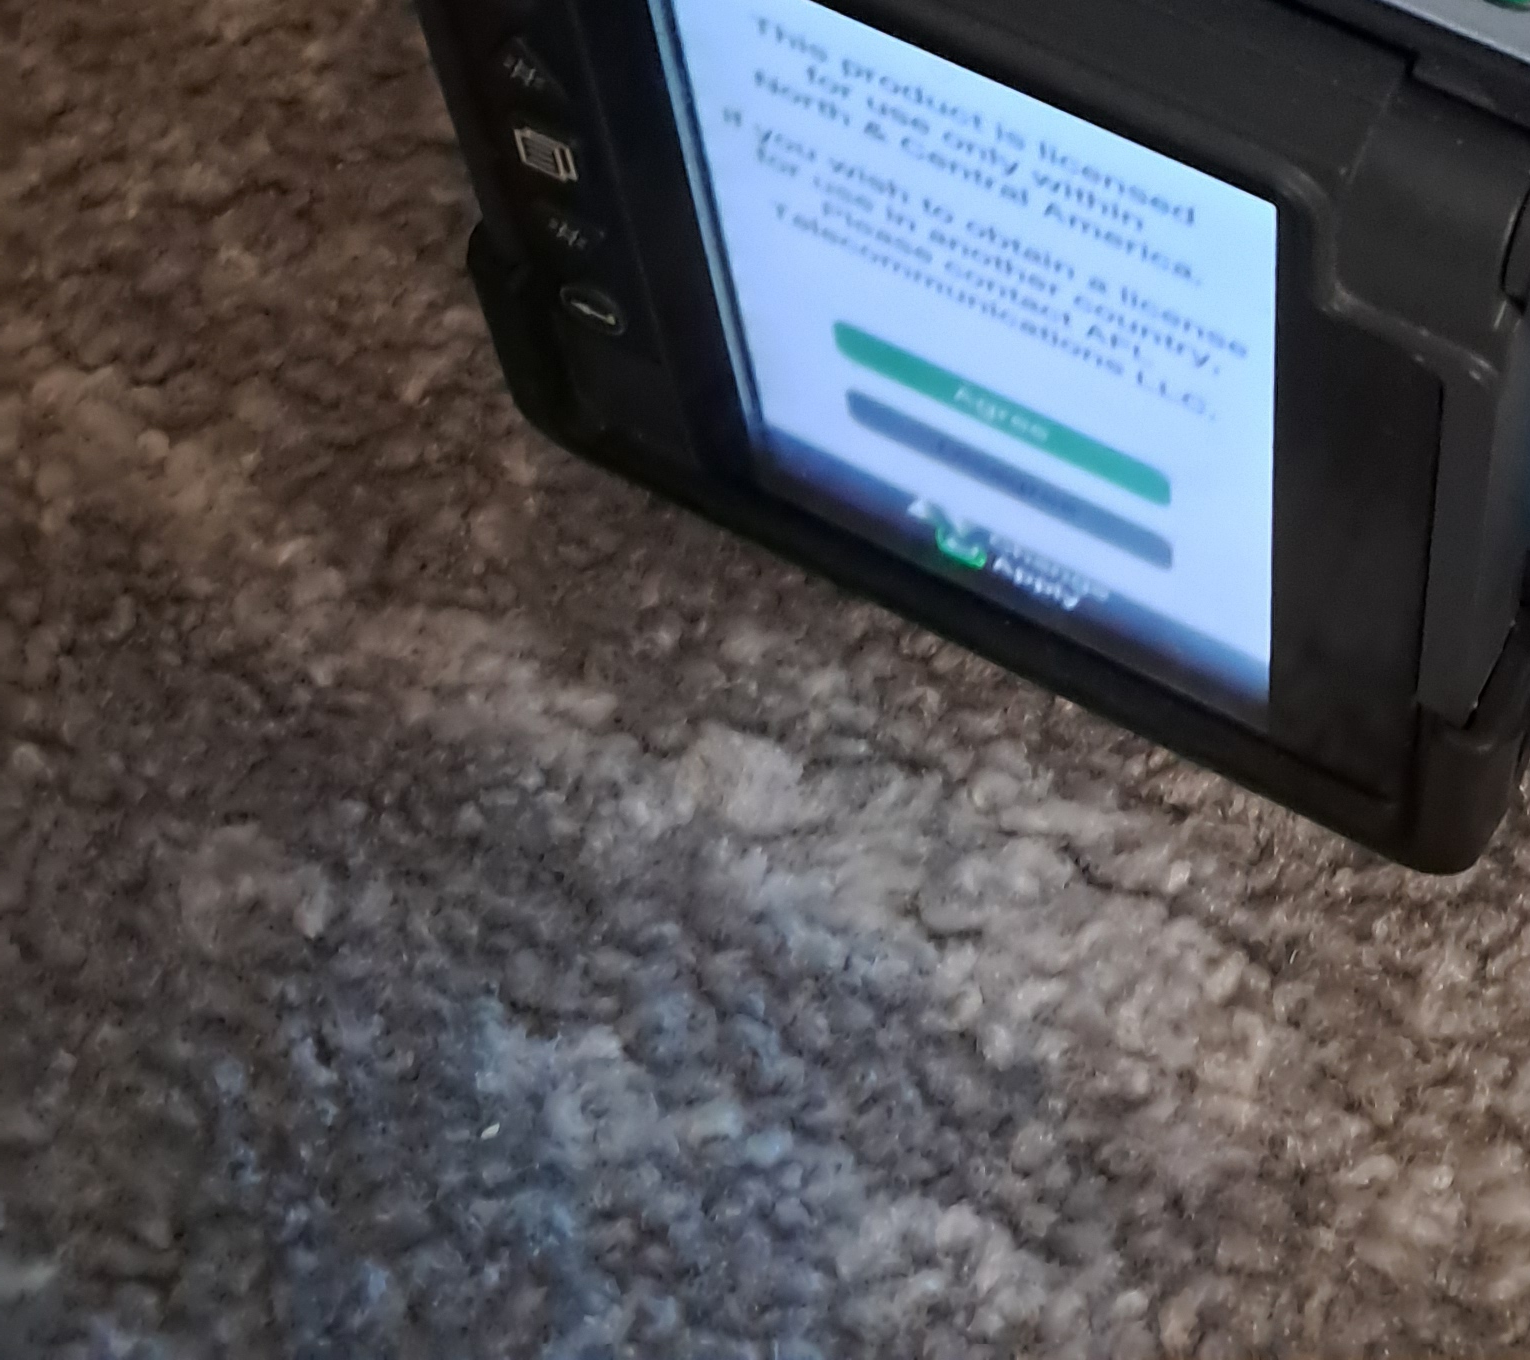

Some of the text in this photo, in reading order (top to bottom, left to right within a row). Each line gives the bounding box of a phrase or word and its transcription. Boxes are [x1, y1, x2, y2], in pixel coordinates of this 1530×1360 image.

[753, 68, 852, 128] North
[901, 135, 1028, 207] Central
[755, 16, 1195, 227] This product is licensed
[806, 64, 1145, 234] for use only within
[922, 196, 954, 225] to
[964, 220, 1074, 281] obtain
[1120, 282, 1247, 358] license
[929, 226, 1058, 298] another
